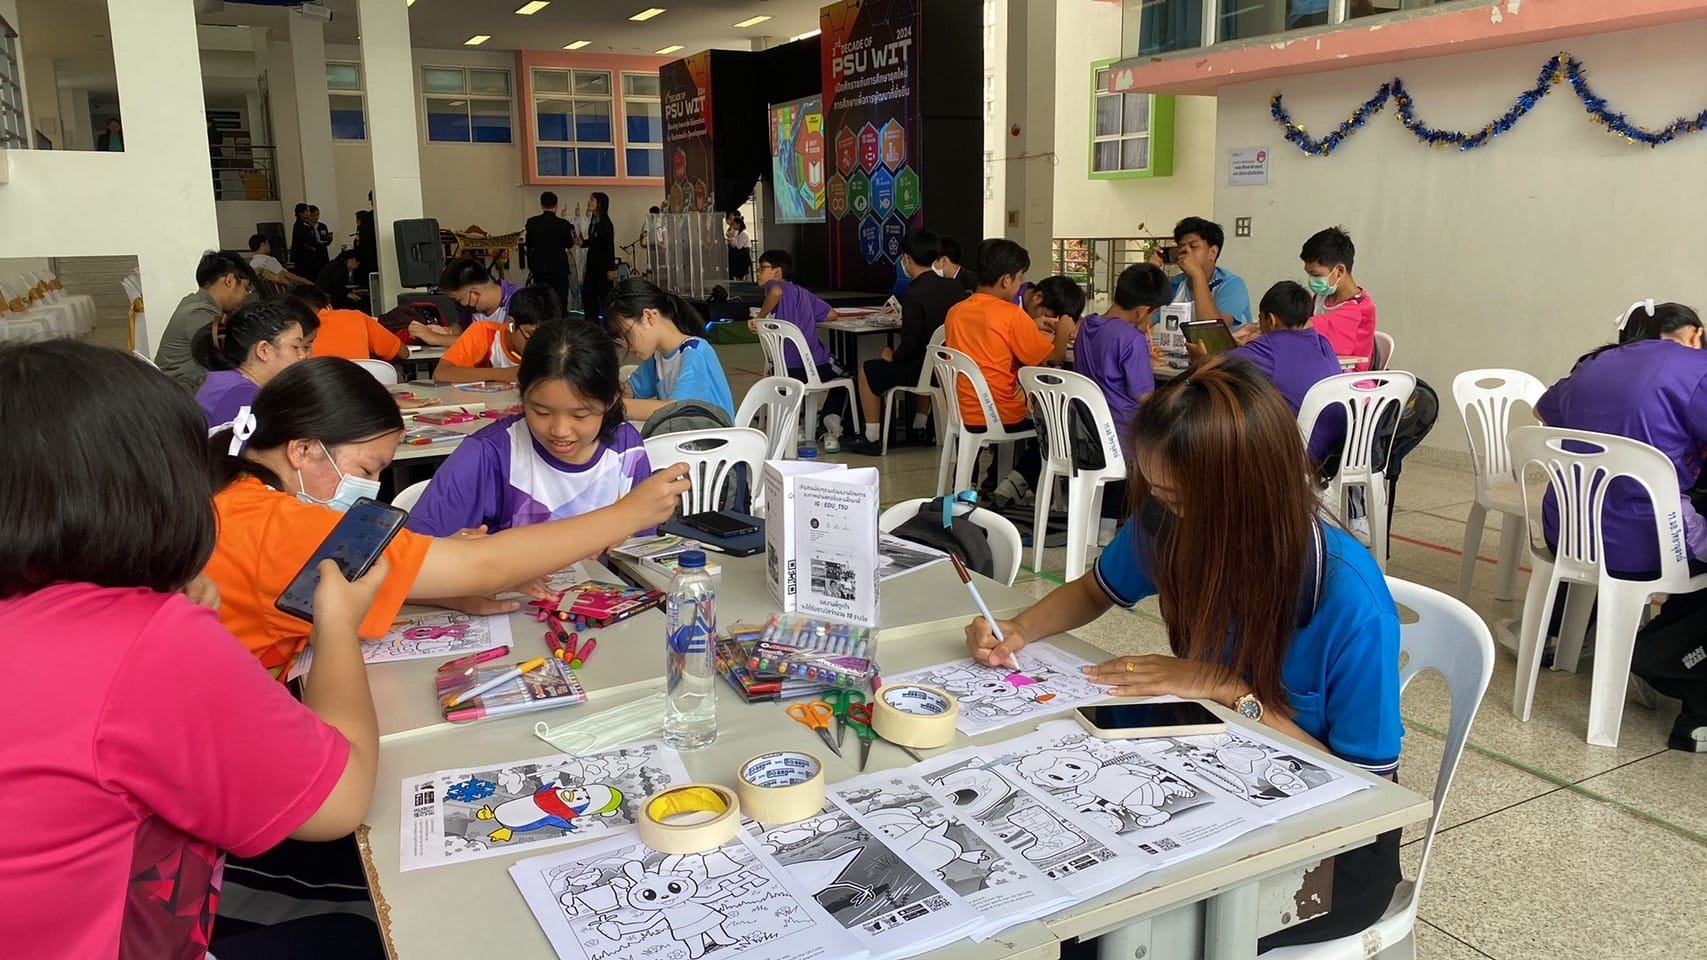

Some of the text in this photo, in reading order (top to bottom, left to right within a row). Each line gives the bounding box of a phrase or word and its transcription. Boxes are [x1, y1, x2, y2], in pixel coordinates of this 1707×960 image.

[896, 26, 912, 40] 2024
[840, 38, 864, 55] DECADE
[864, 36, 873, 48] OF
[832, 38, 912, 79] PSU WIT
[665, 95, 706, 120] PSU WIT
[824, 501, 849, 511] EDU_TSU
